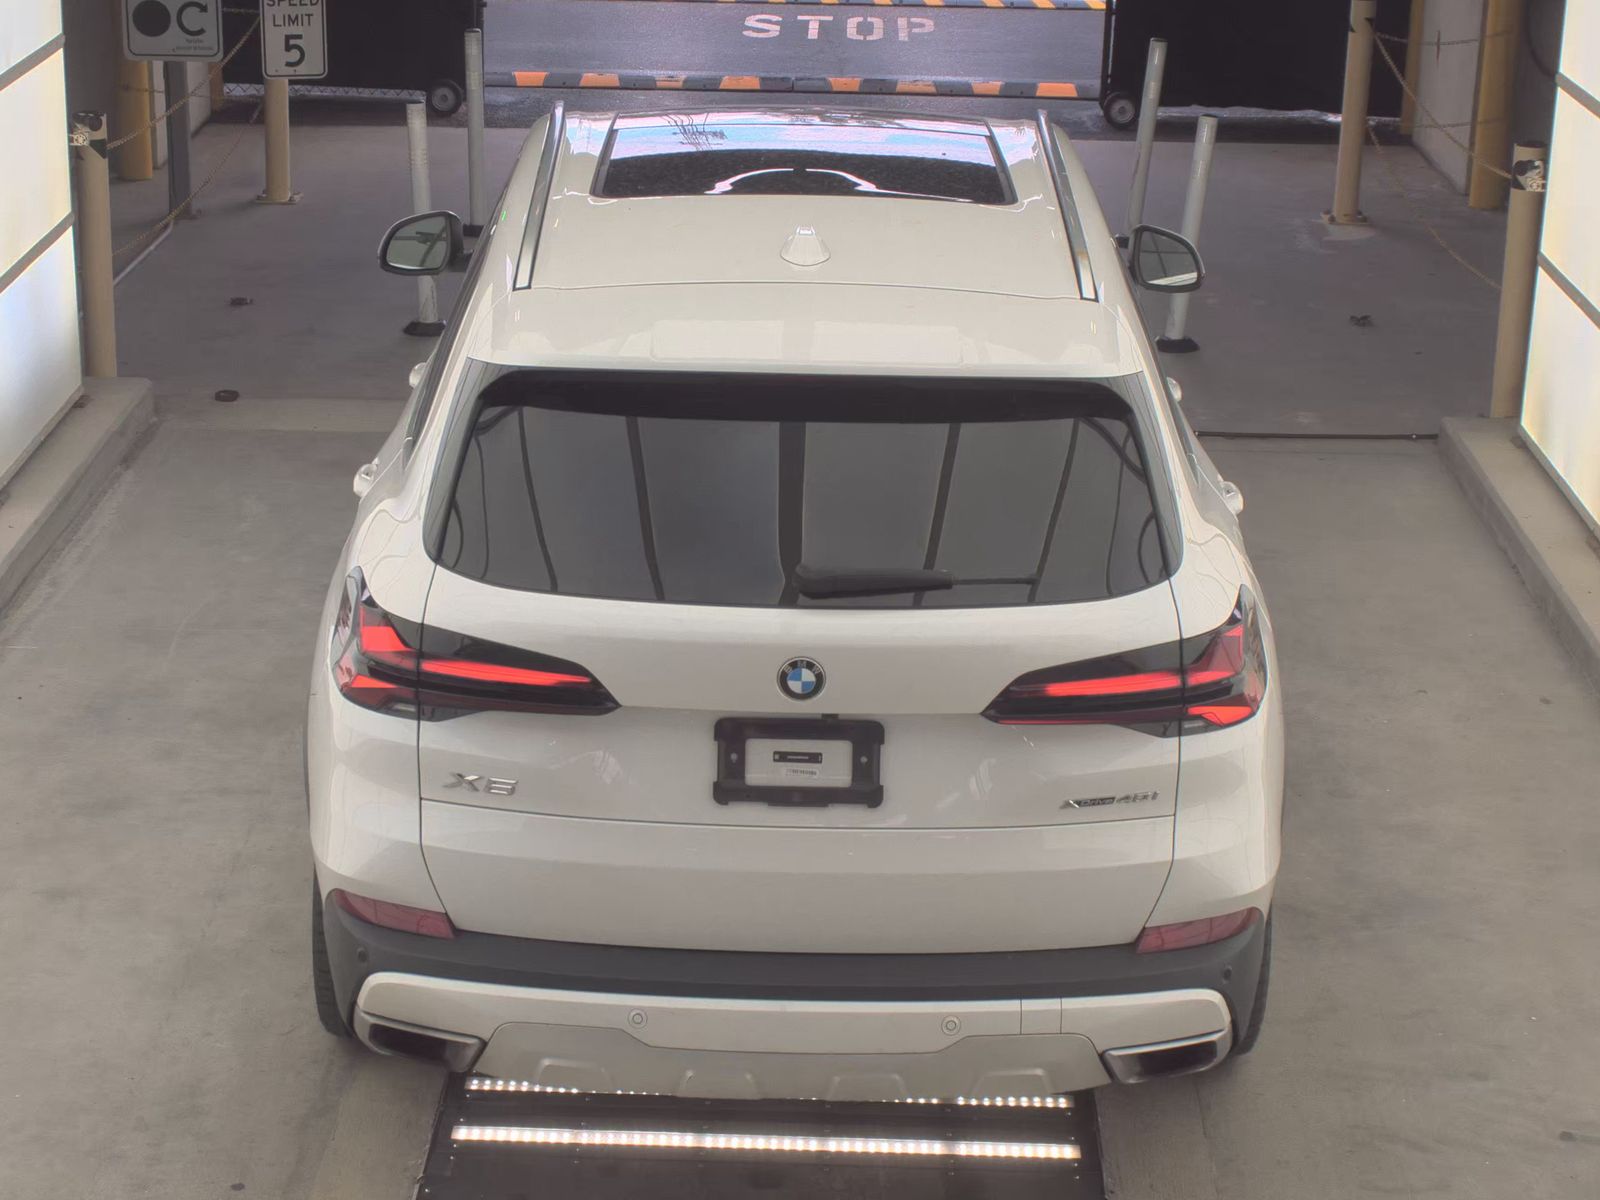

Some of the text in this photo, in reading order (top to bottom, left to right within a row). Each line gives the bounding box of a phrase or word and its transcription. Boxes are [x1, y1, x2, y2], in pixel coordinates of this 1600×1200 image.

[272, 13, 314, 27] LIMIT
[742, 14, 935, 41] STOP
[284, 34, 305, 67] 5
